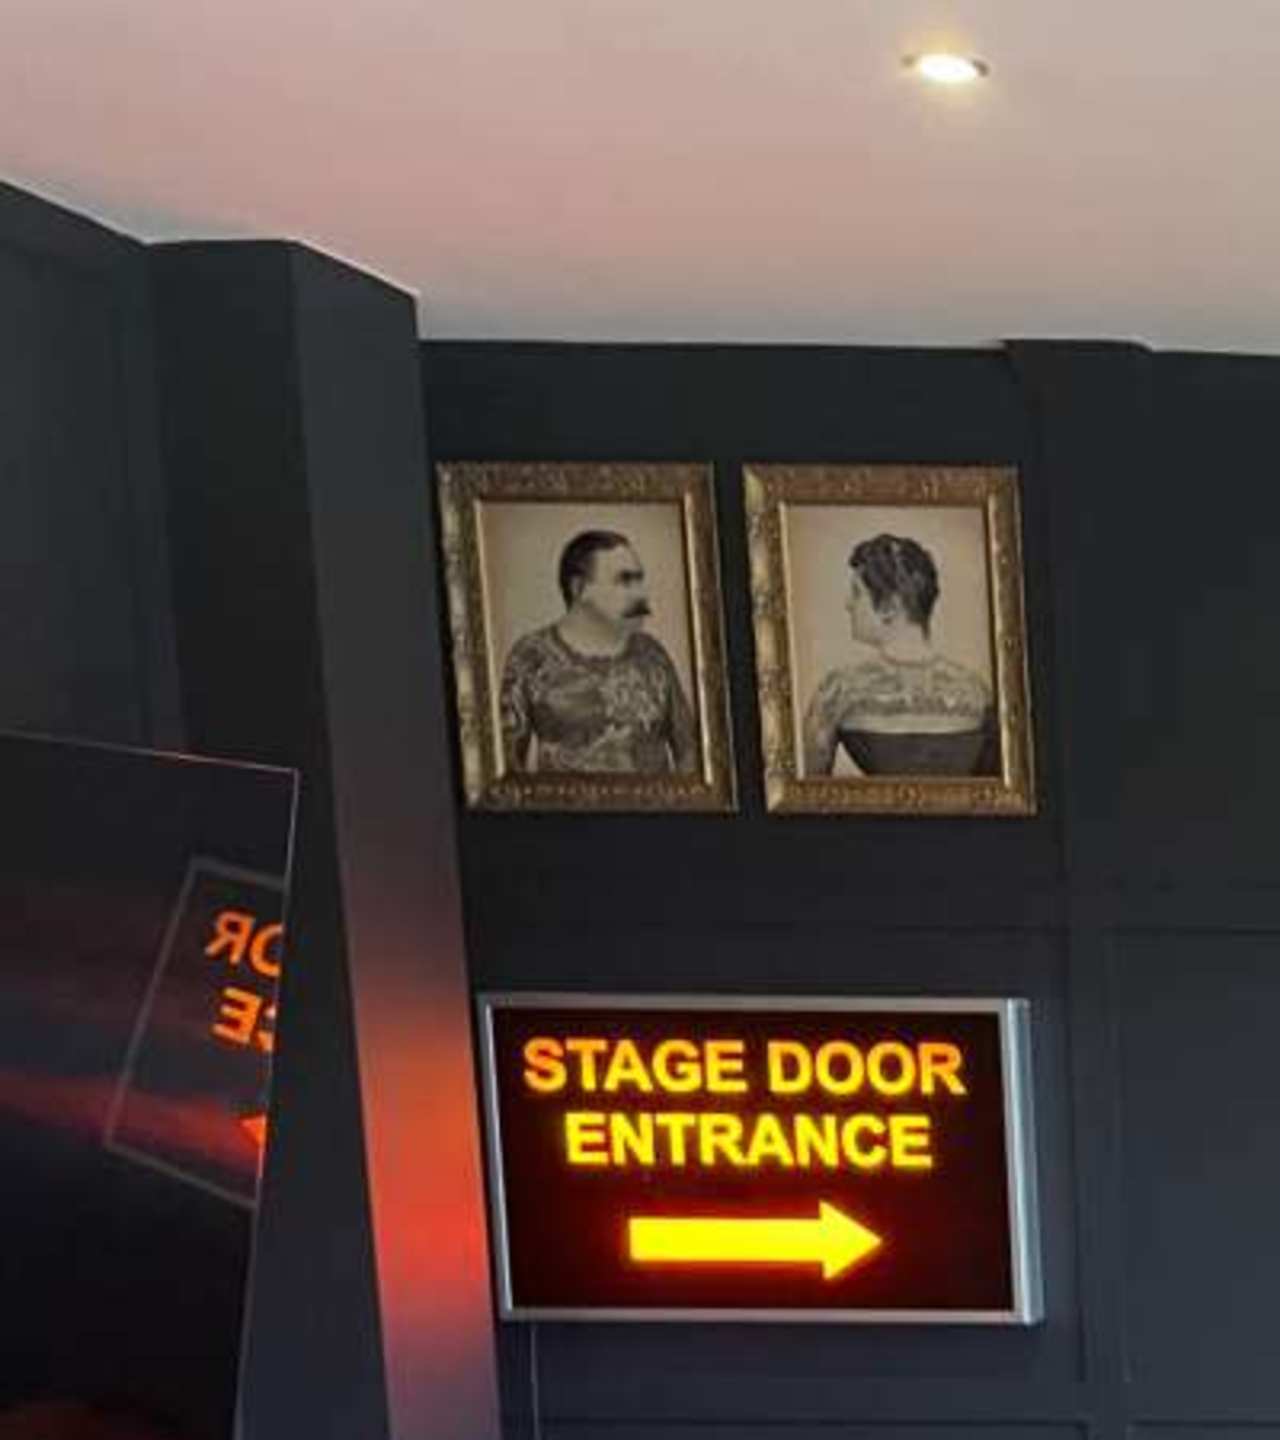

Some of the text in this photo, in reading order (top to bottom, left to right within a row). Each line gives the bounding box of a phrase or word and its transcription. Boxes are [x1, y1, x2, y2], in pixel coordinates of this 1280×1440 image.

[522, 1037, 967, 1096] STAGE DOOR
[564, 1112, 933, 1168] ENTRANCE
